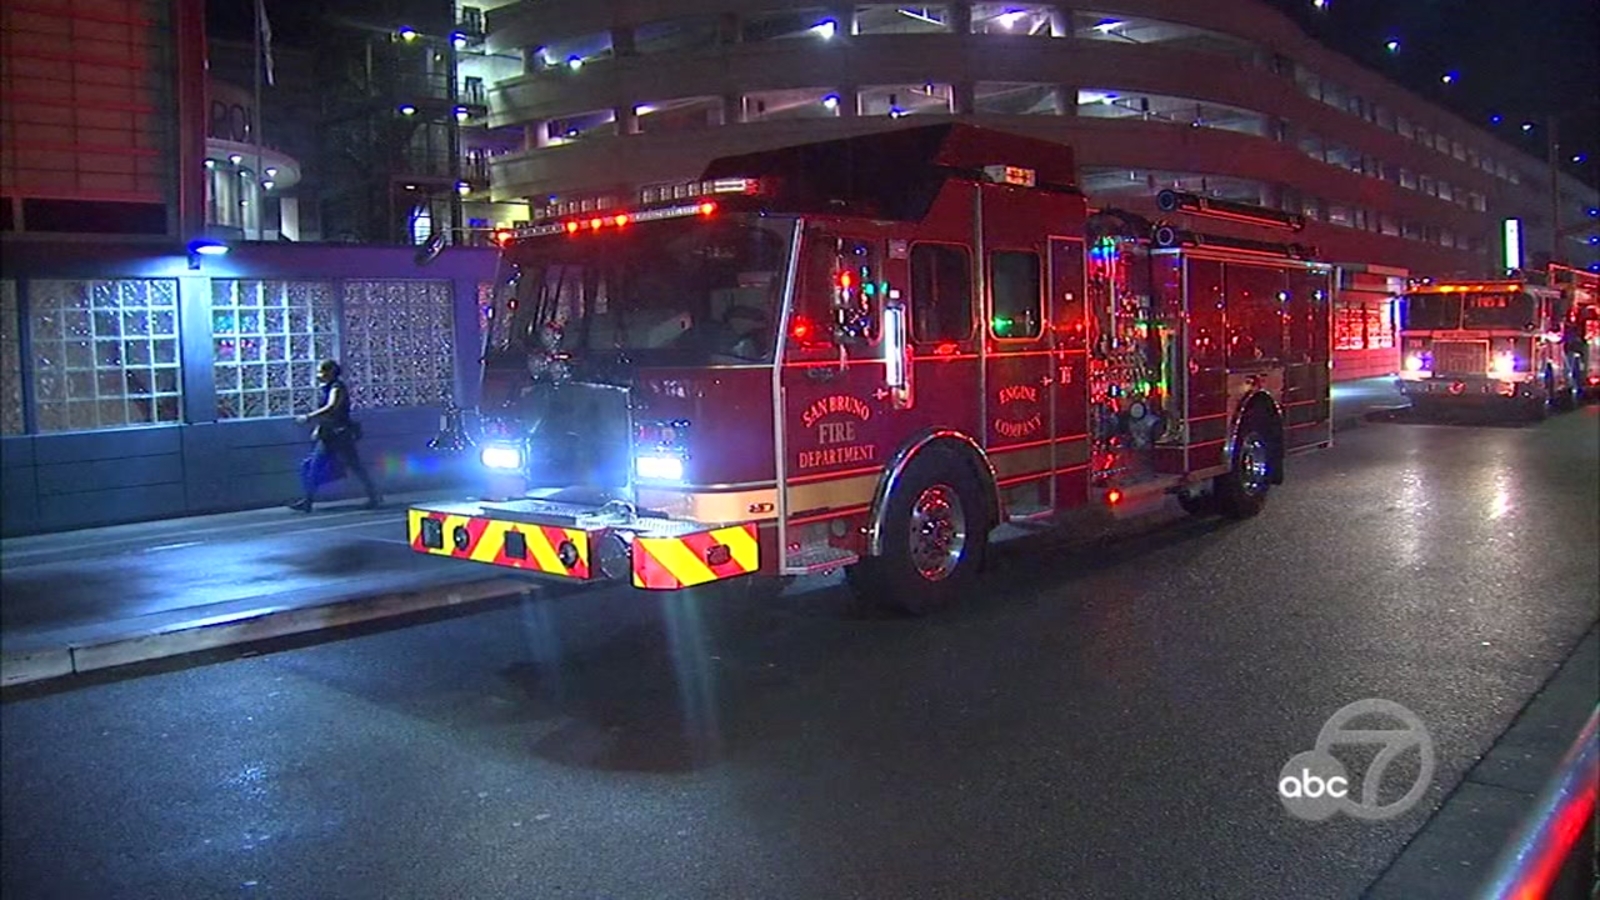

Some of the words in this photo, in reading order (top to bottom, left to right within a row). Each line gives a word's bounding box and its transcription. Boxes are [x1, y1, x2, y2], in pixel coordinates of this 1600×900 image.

[999, 385, 1036, 404] ENGINE
[802, 398, 828, 428] SAN
[829, 395, 870, 421] BRUNO
[819, 421, 856, 444] FIRE
[995, 412, 1041, 437] COMPANY
[799, 445, 875, 468] DEPARTMENT
